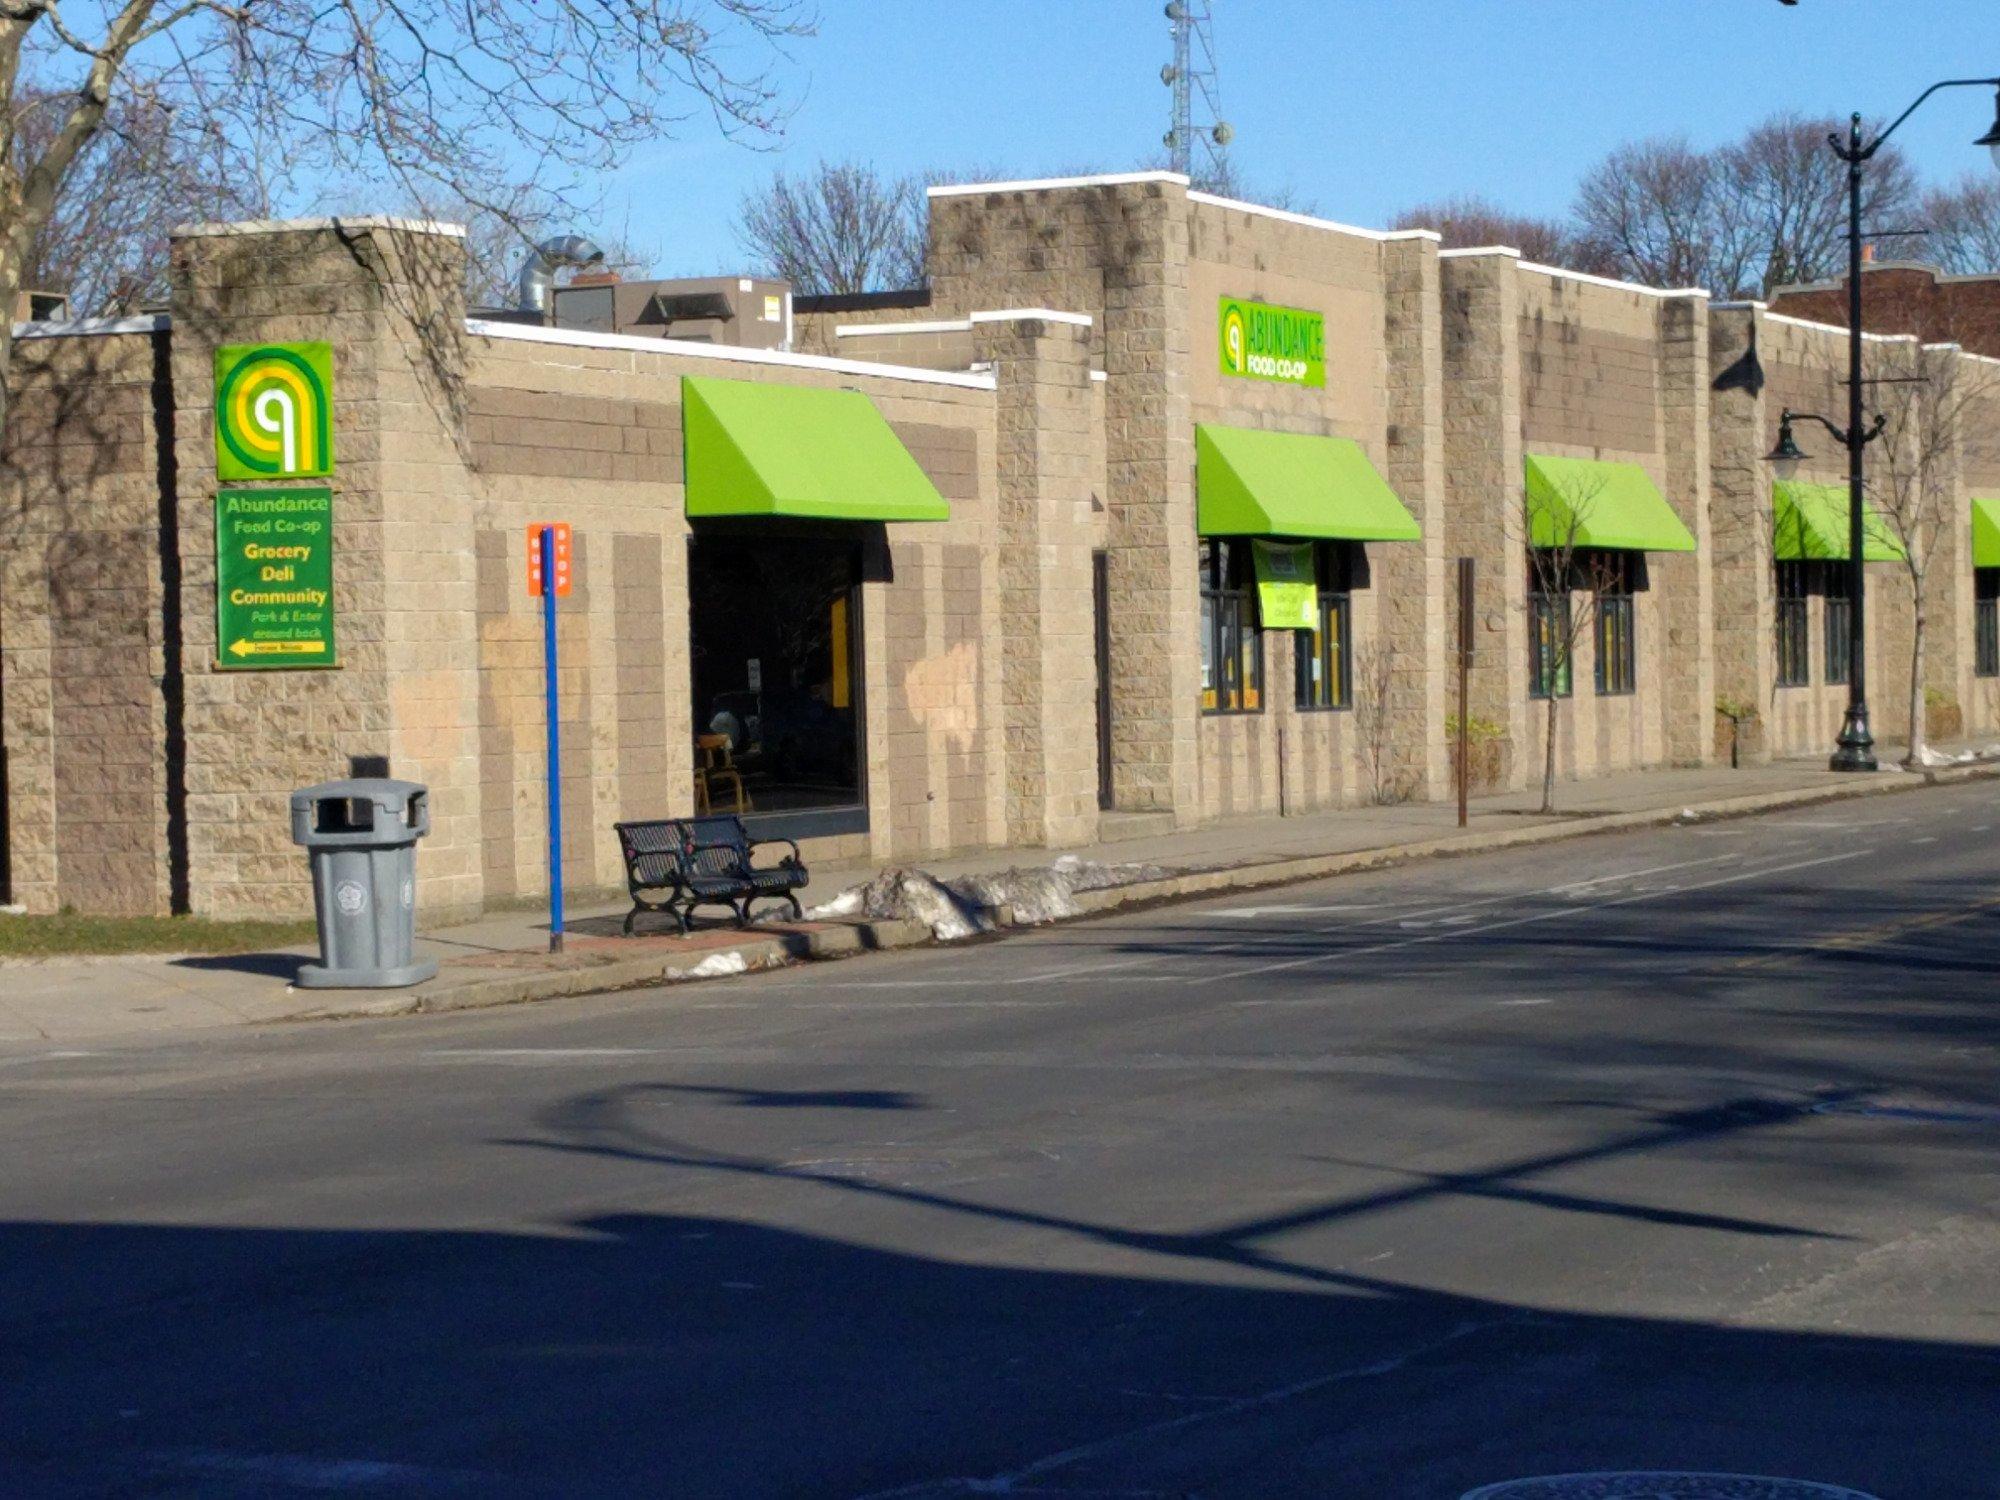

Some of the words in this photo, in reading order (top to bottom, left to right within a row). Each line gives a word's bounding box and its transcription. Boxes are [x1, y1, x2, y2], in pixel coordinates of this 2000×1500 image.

[1246, 308, 1322, 362] ABUNDANCE
[1247, 354, 1276, 376] FOOD
[1276, 358, 1307, 380] CO-OP
[226, 497, 329, 513] Abundance
[234, 520, 271, 534] Food
[274, 519, 322, 535] Co-op
[244, 543, 312, 561] Grocery
[557, 528, 568, 587] STOP
[260, 565, 295, 581] Deli
[230, 588, 328, 608] Community
